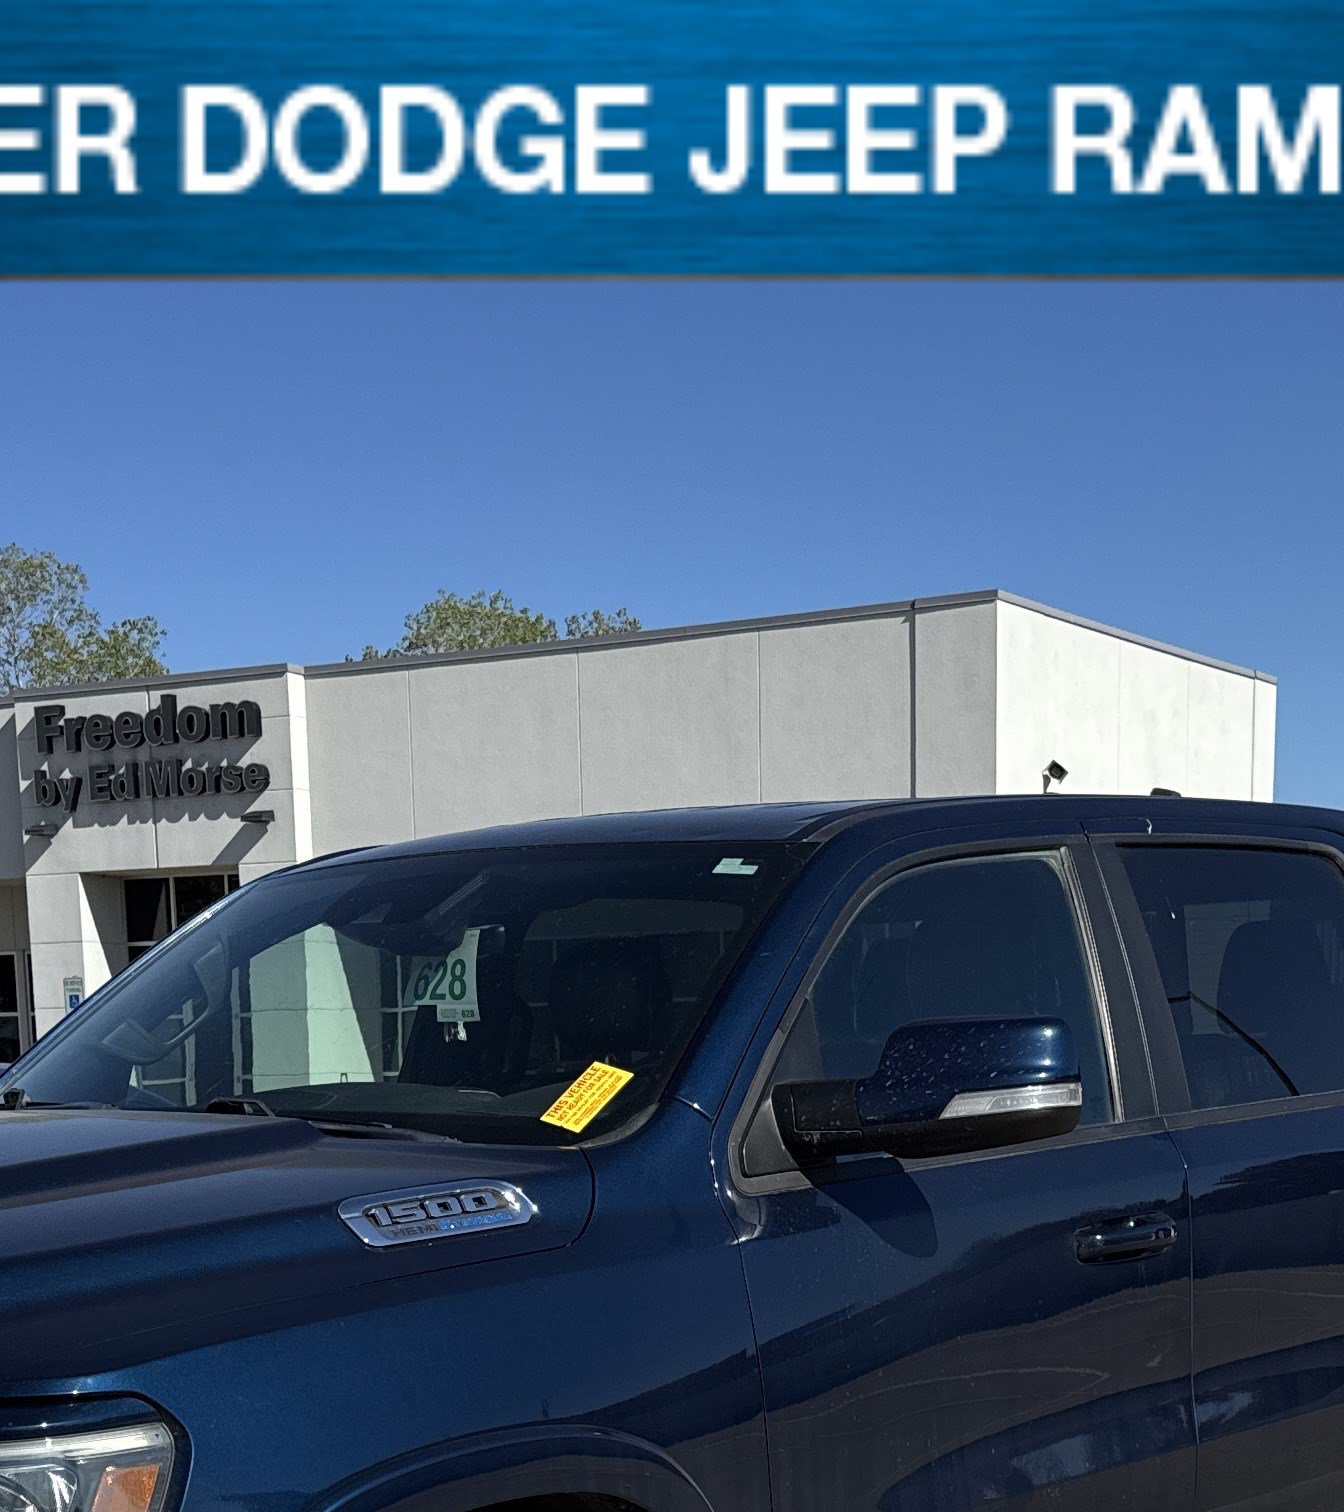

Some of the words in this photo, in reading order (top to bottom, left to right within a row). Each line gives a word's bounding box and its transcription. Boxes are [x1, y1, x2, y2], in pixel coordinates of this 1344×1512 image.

[34, 694, 262, 753] Freedom
[33, 769, 83, 813] by
[88, 762, 141, 801] Ed
[144, 758, 270, 798] Morse
[414, 958, 467, 1001] 628
[545, 1099, 569, 1118] THIS
[564, 1065, 601, 1099] VEHICLE
[369, 1190, 499, 1228] 1500
[390, 1223, 441, 1238] HEMI
